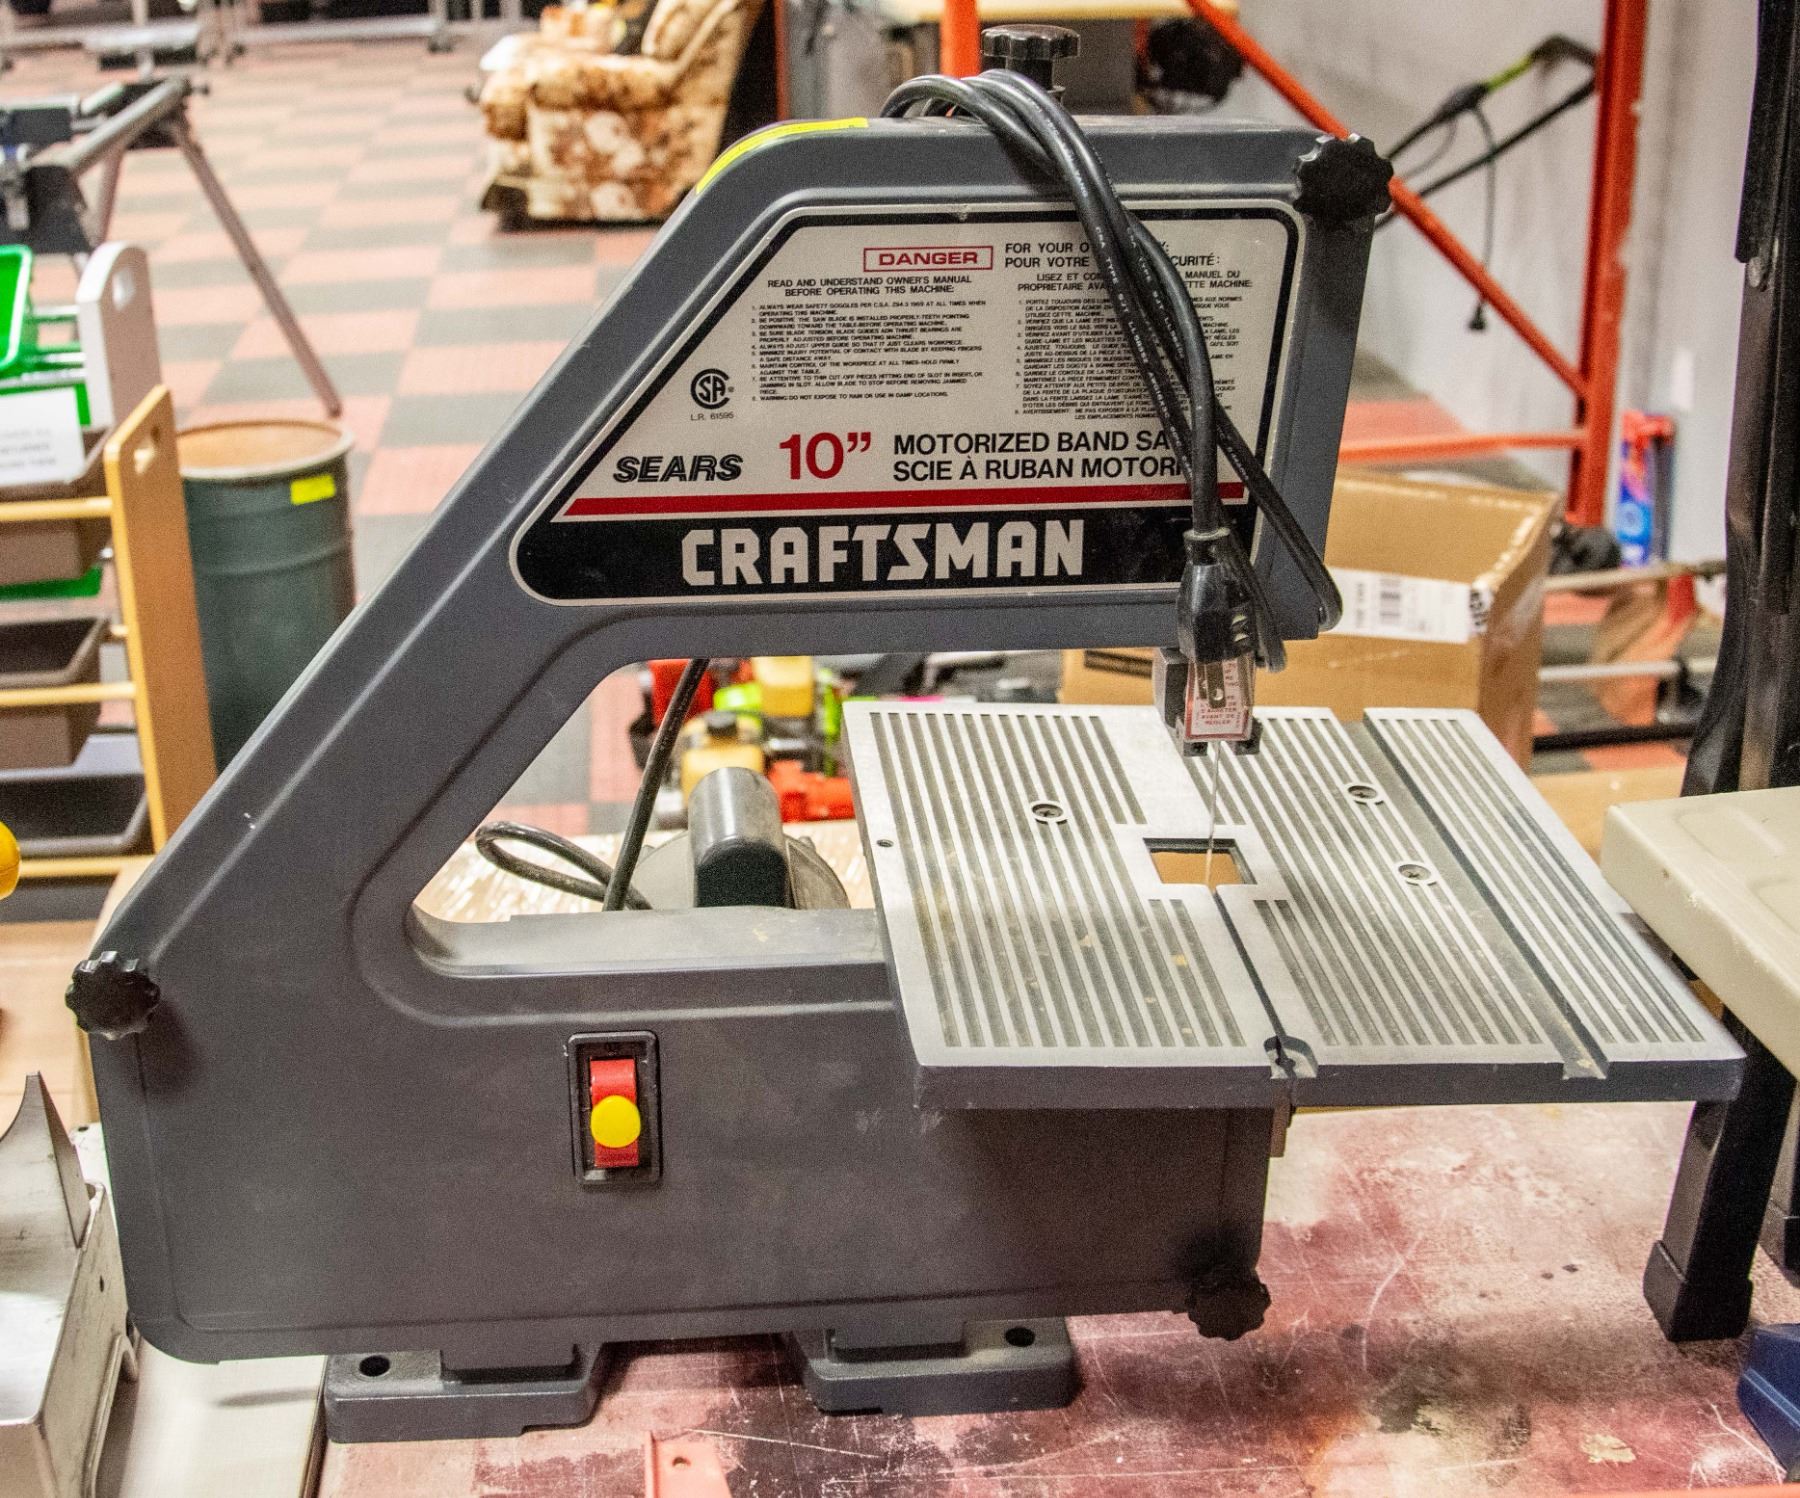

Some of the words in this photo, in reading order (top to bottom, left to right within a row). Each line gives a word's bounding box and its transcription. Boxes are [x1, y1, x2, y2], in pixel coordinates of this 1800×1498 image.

[1005, 243, 1031, 254] FOR
[1038, 242, 1074, 254] YOUR
[879, 252, 978, 266] DANGER
[1004, 257, 1040, 268] POUR
[1047, 256, 1090, 267] VOTRE
[820, 278, 883, 286] UNDERSTAND
[933, 275, 972, 284] MANUAL
[1036, 273, 1062, 281] LISEZ
[1185, 270, 1224, 279] MANUEL
[785, 288, 822, 296] BEFORE
[826, 286, 880, 295] OPERATING
[885, 286, 906, 294] THIS
[1018, 282, 1083, 291] PROPRIETAIRE
[894, 432, 1049, 455] MOTORIZED
[1057, 431, 1129, 452] BAND
[1136, 430, 1171, 450] SA
[613, 454, 744, 483] SEARS
[893, 460, 952, 482] SCIE
[959, 455, 978, 480] À
[986, 458, 1074, 480] RUBAN
[681, 519, 1084, 586] CRAFTSMAN
